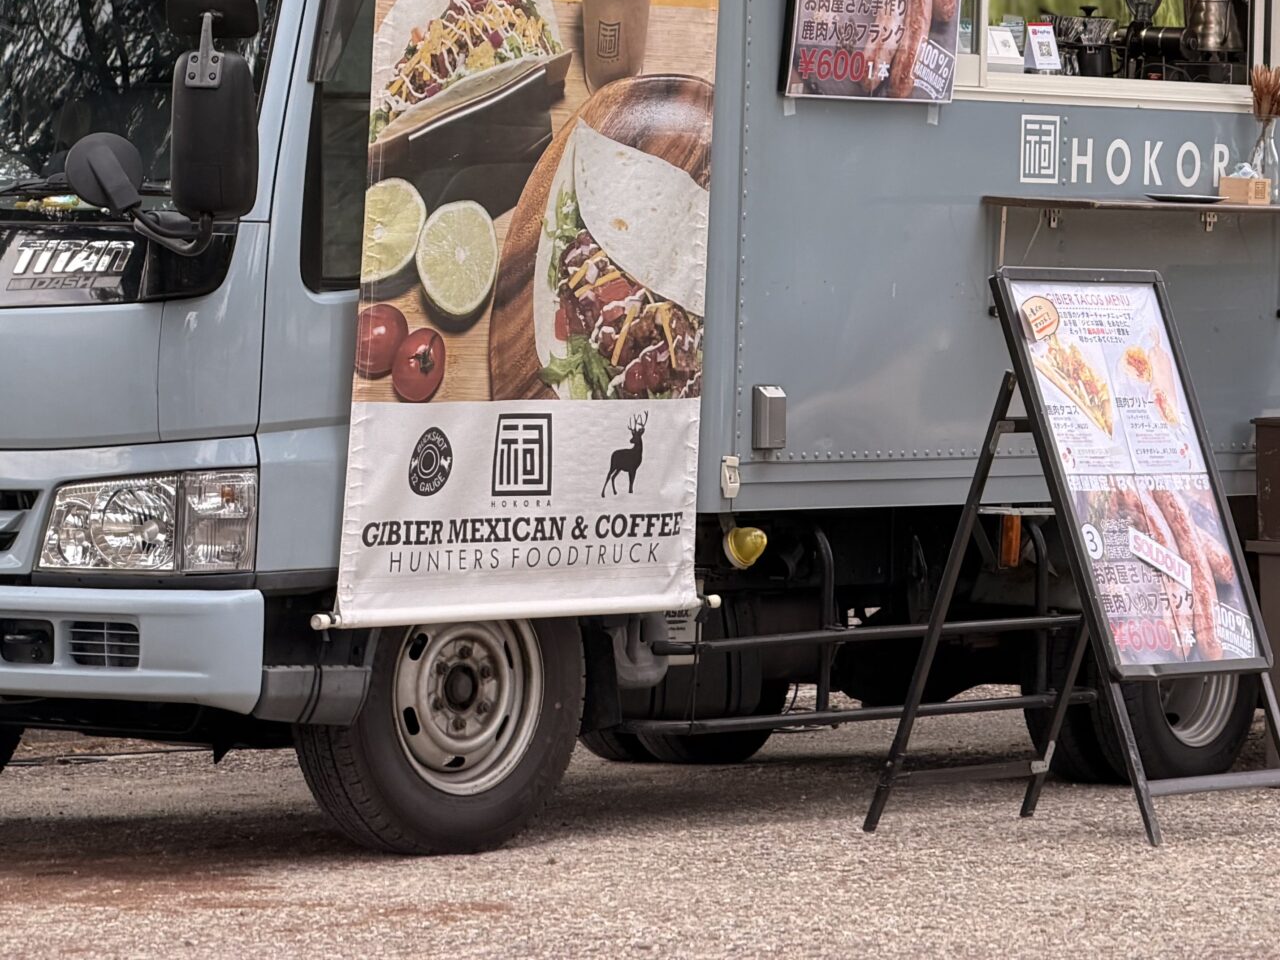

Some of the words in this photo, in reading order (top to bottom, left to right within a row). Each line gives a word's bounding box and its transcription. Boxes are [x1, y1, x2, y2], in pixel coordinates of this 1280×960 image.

[801, 20, 905, 44] 鹿肉入りフランク
[799, 48, 865, 81] ¥600
[920, 42, 949, 78] 100%
[1070, 138, 1231, 188] HOKOR
[13, 240, 135, 275] TITAN
[32, 277, 95, 289] DASH
[419, 472, 446, 493] GAUGE
[491, 500, 552, 508] HOKORA
[362, 519, 443, 548] GIBIER
[447, 516, 566, 544] MEXICAN
[571, 516, 588, 539] &
[594, 511, 683, 539] COFFEE
[390, 547, 500, 573] HUNTERS
[512, 542, 660, 569] FOODTRUCK
[1100, 592, 1194, 613] 鹿肉入りフランク
[1112, 618, 1172, 652] ¥600
[1214, 604, 1251, 638] 100%
